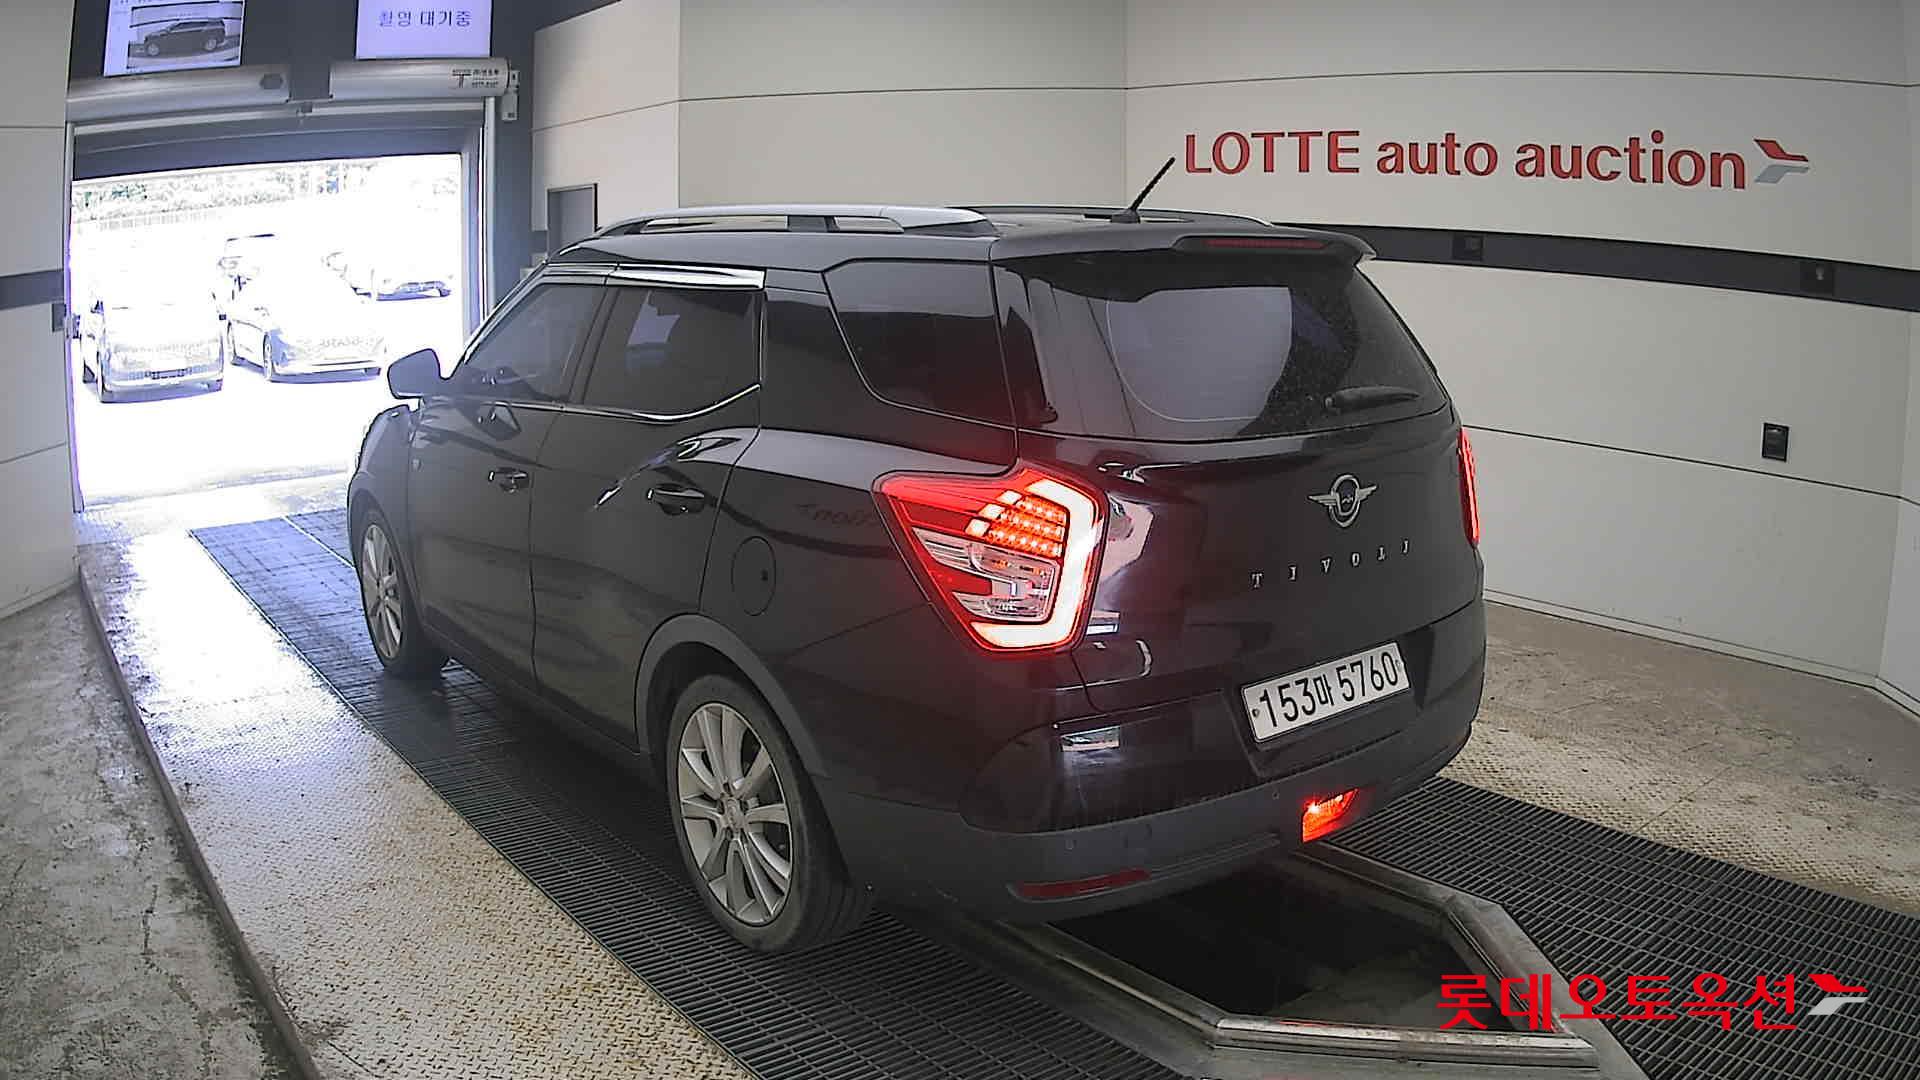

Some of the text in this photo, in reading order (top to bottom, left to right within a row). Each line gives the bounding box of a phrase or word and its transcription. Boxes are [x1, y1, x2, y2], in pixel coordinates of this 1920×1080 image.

[420, 10, 472, 27] 대기중
[1185, 131, 1746, 188] LOTTE auto auction
[1251, 539, 1410, 589] TIVOLI
